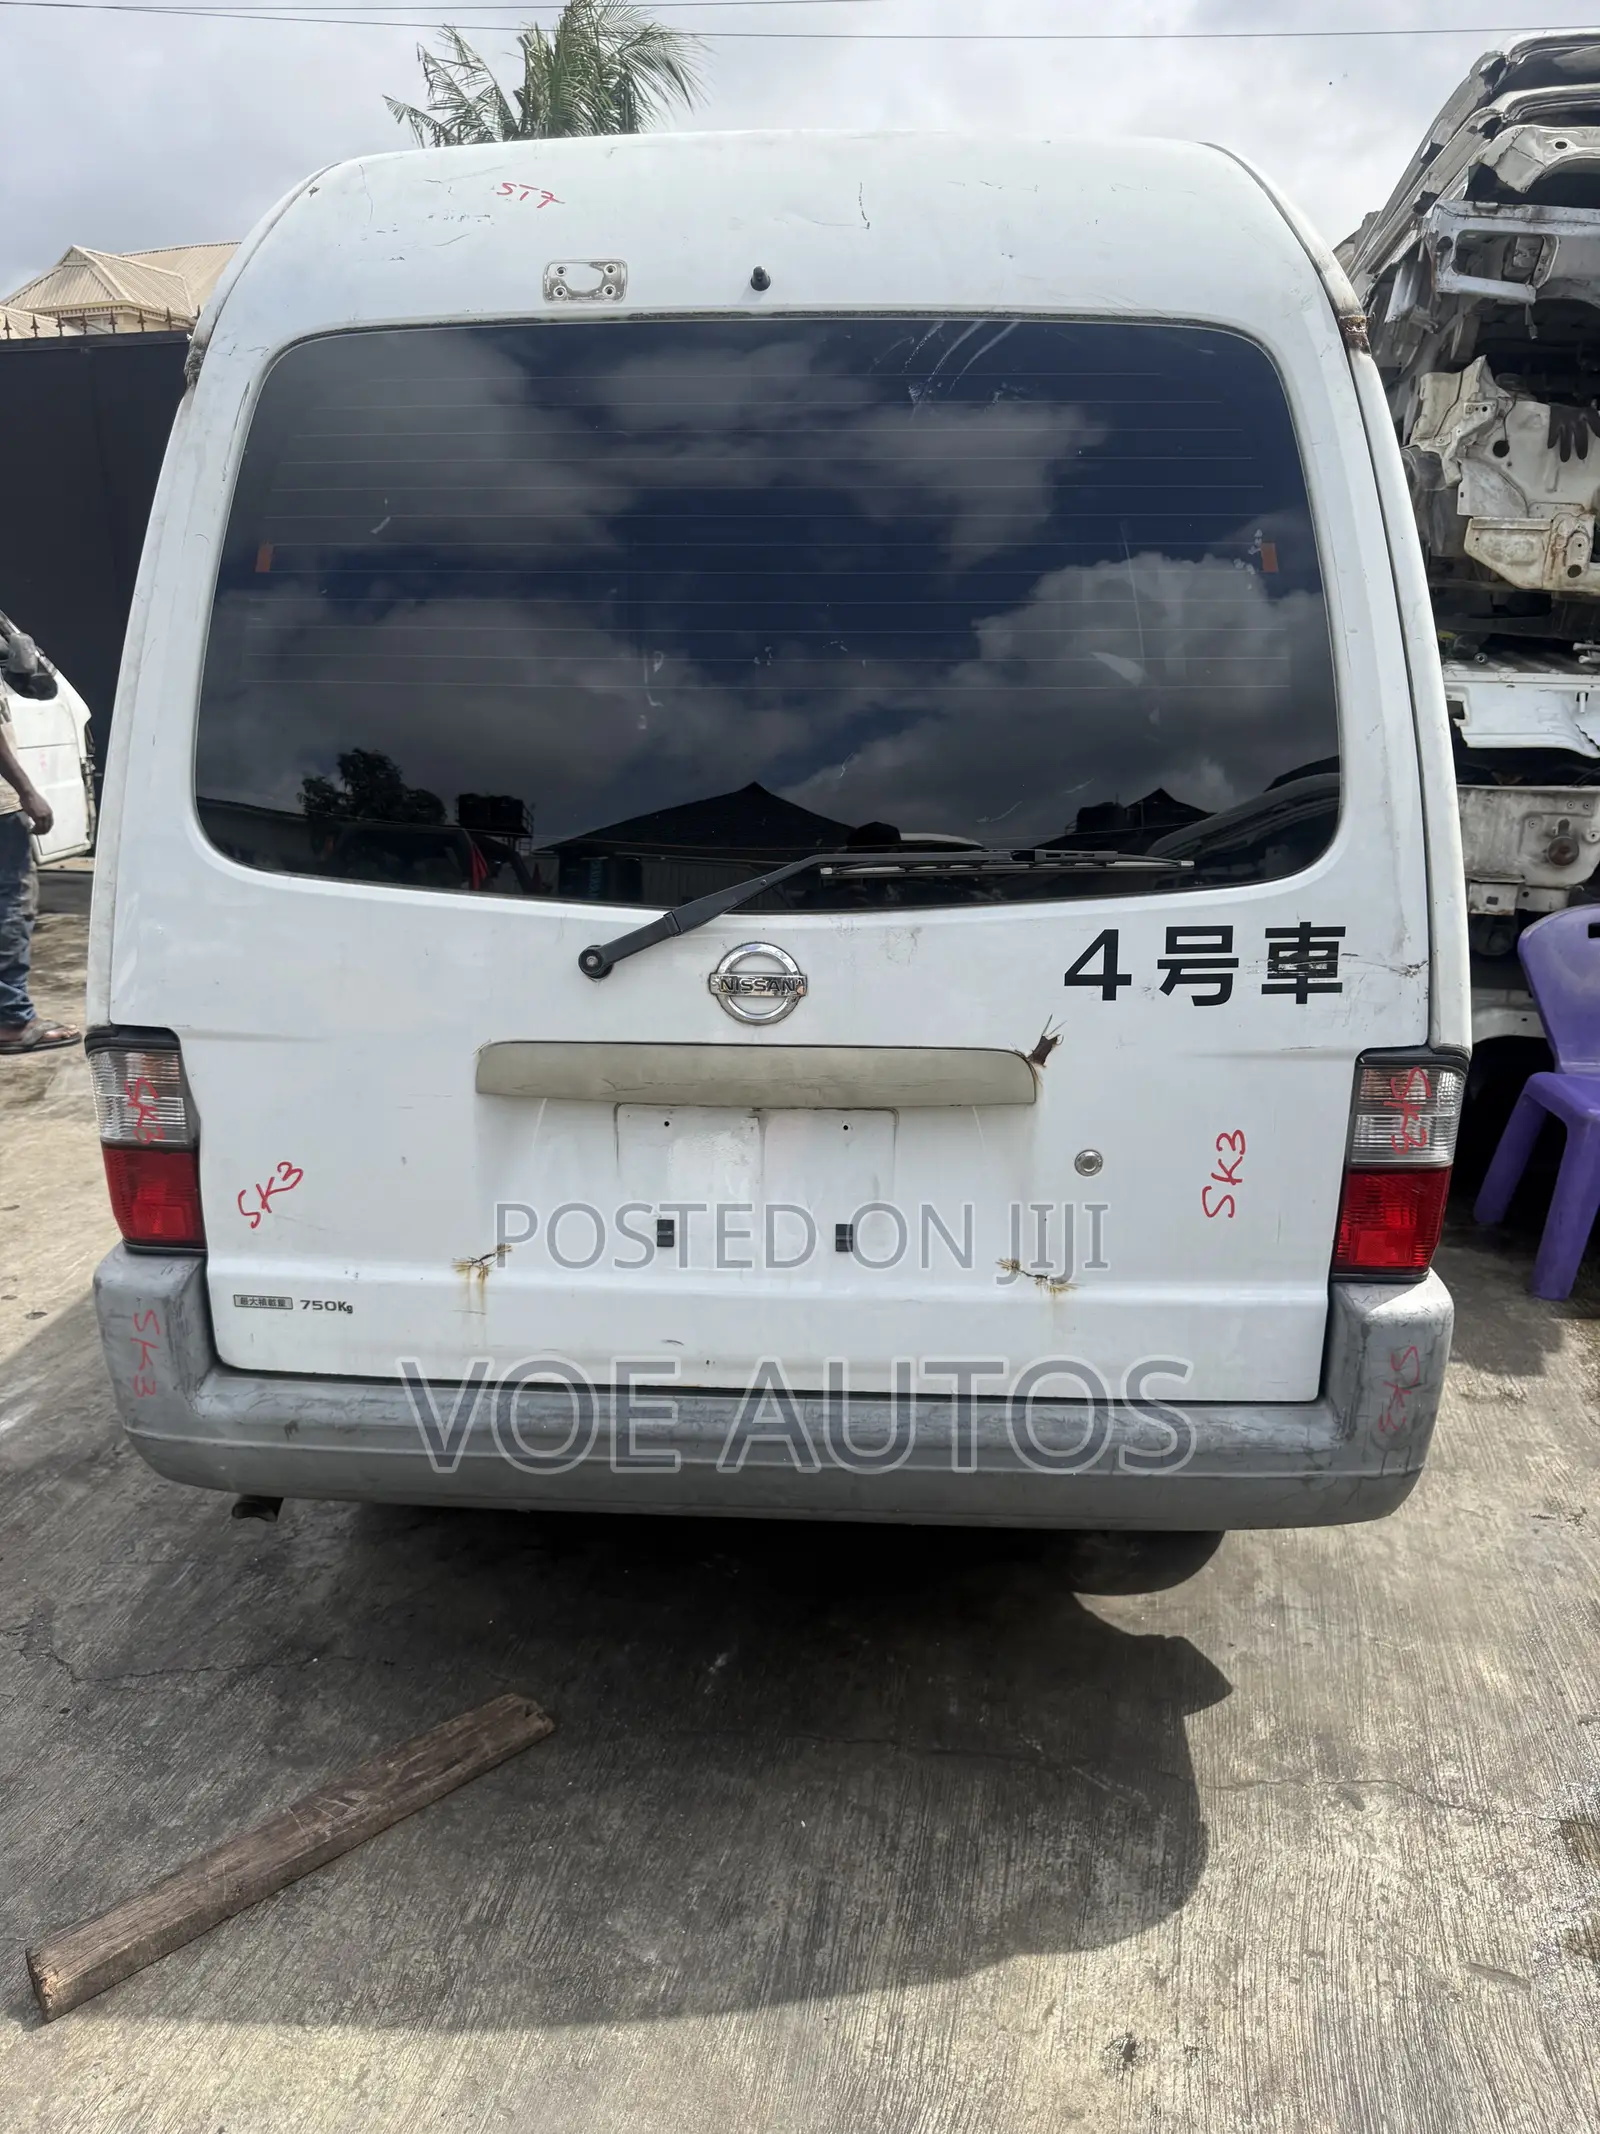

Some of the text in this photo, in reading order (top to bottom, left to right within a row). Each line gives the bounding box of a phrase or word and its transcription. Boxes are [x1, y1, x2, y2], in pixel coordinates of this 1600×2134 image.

[719, 978, 795, 993] NISSAN
[1063, 921, 1347, 1007] 4号車
[236, 1161, 304, 1229] SK3
[1201, 1128, 1246, 1219] SK3
[300, 1300, 353, 1314] 750Kg
[130, 1309, 160, 1398] SK3
